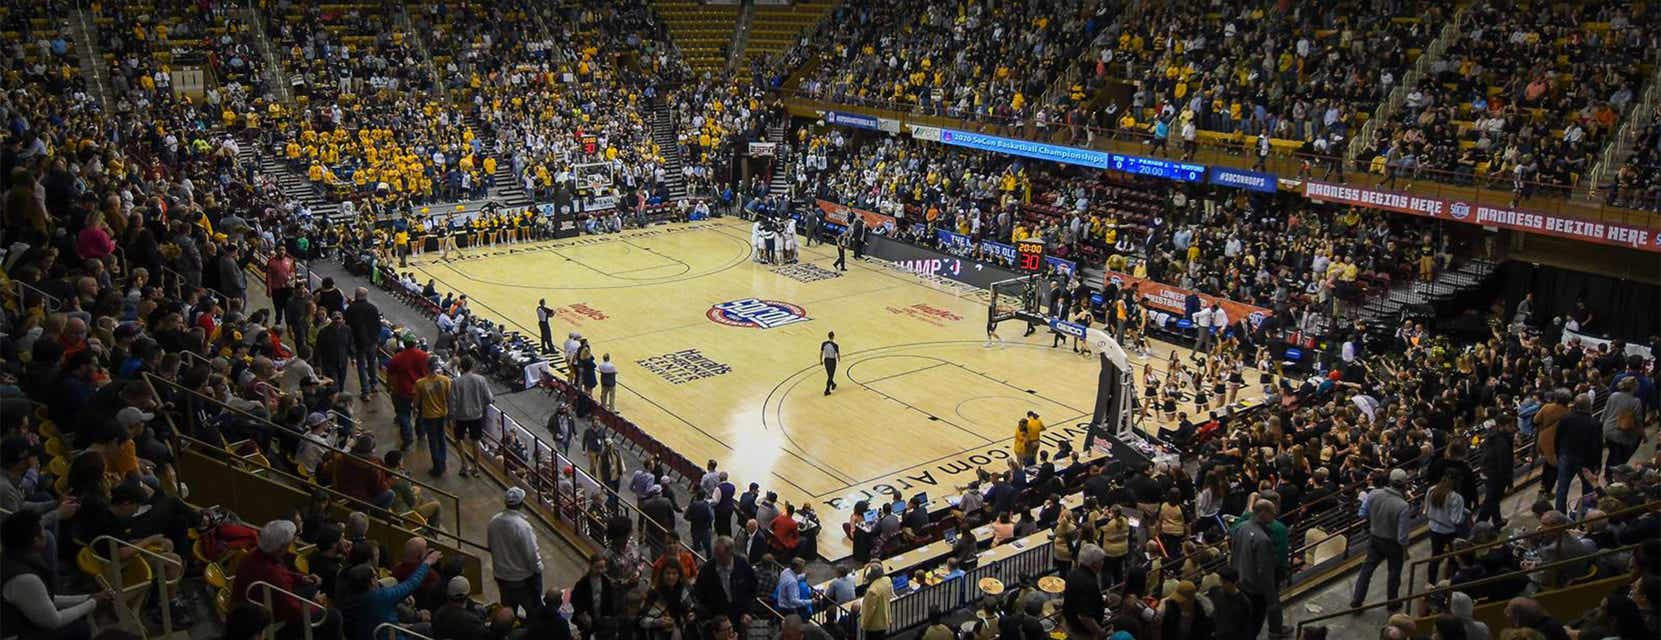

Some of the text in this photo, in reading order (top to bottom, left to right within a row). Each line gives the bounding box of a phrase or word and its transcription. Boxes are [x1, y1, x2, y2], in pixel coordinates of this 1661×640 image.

[954, 135, 1104, 164] 2020 SoCon Basketball Championships
[1306, 182, 1443, 215] MADNESS BEGINS HERE
[1476, 207, 1543, 229] MADNESS
[1545, 217, 1604, 237] BEGINS
[1607, 225, 1648, 248] HERE
[1018, 243, 1042, 254] 20:00
[1021, 253, 1039, 270] 30
[1056, 322, 1083, 337] GEICO
